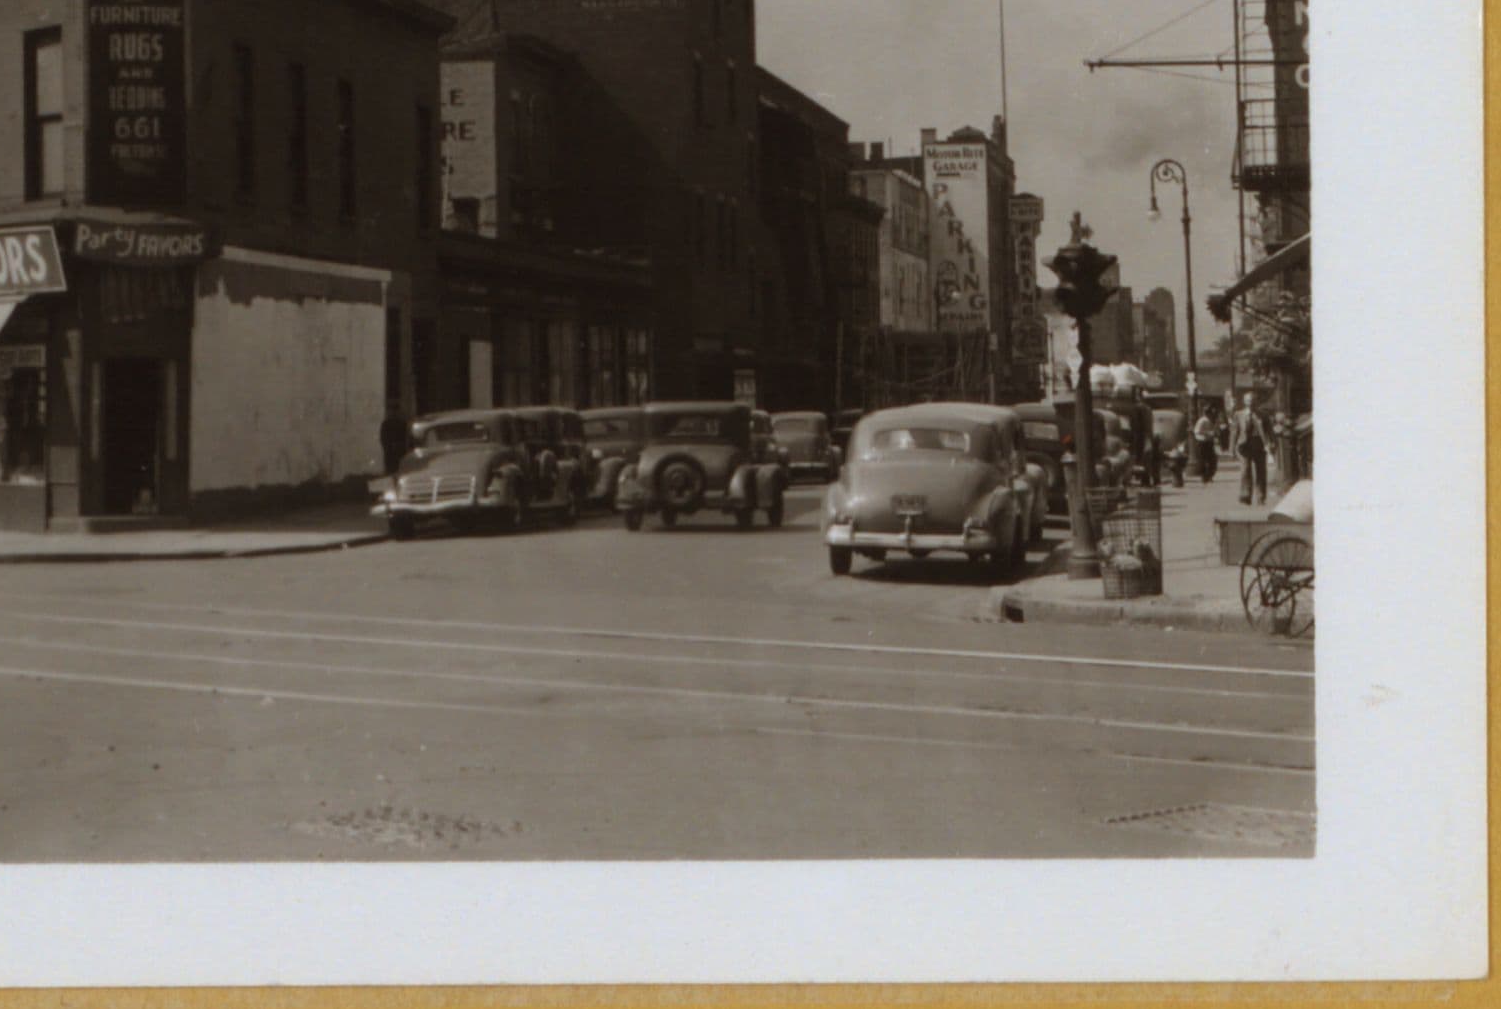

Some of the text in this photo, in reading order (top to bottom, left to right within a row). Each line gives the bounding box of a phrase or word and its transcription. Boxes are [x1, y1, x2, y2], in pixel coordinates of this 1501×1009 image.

[89, 5, 183, 28] FURNITURE
[108, 32, 165, 62] RUGS
[113, 115, 161, 140] 661
[932, 160, 978, 173] GARAGE
[932, 182, 988, 311] PARKING
